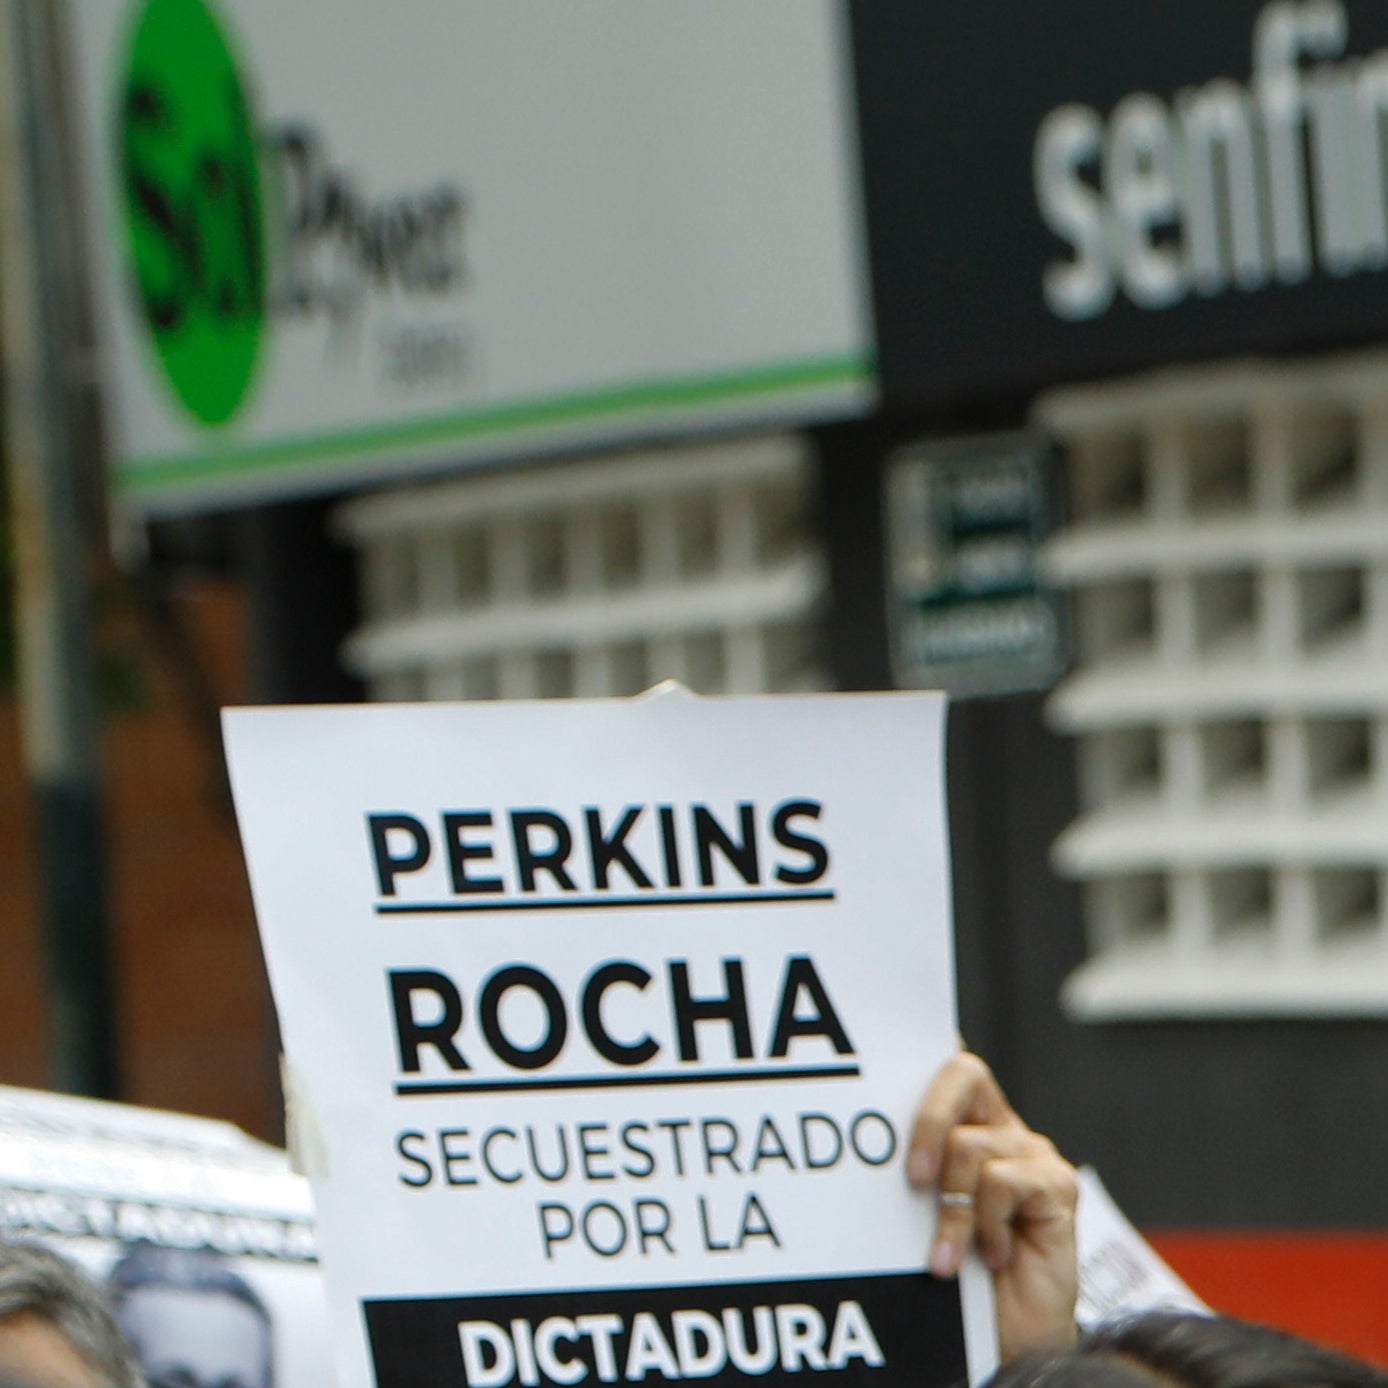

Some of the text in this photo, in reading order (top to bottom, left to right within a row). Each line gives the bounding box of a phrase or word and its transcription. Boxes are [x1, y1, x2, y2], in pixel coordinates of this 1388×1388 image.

[365, 798, 831, 897] PERKINS
[386, 953, 857, 1075] ROCHA
[395, 1109, 899, 1190] SECUESTRADO
[536, 1192, 783, 1262] POR LA
